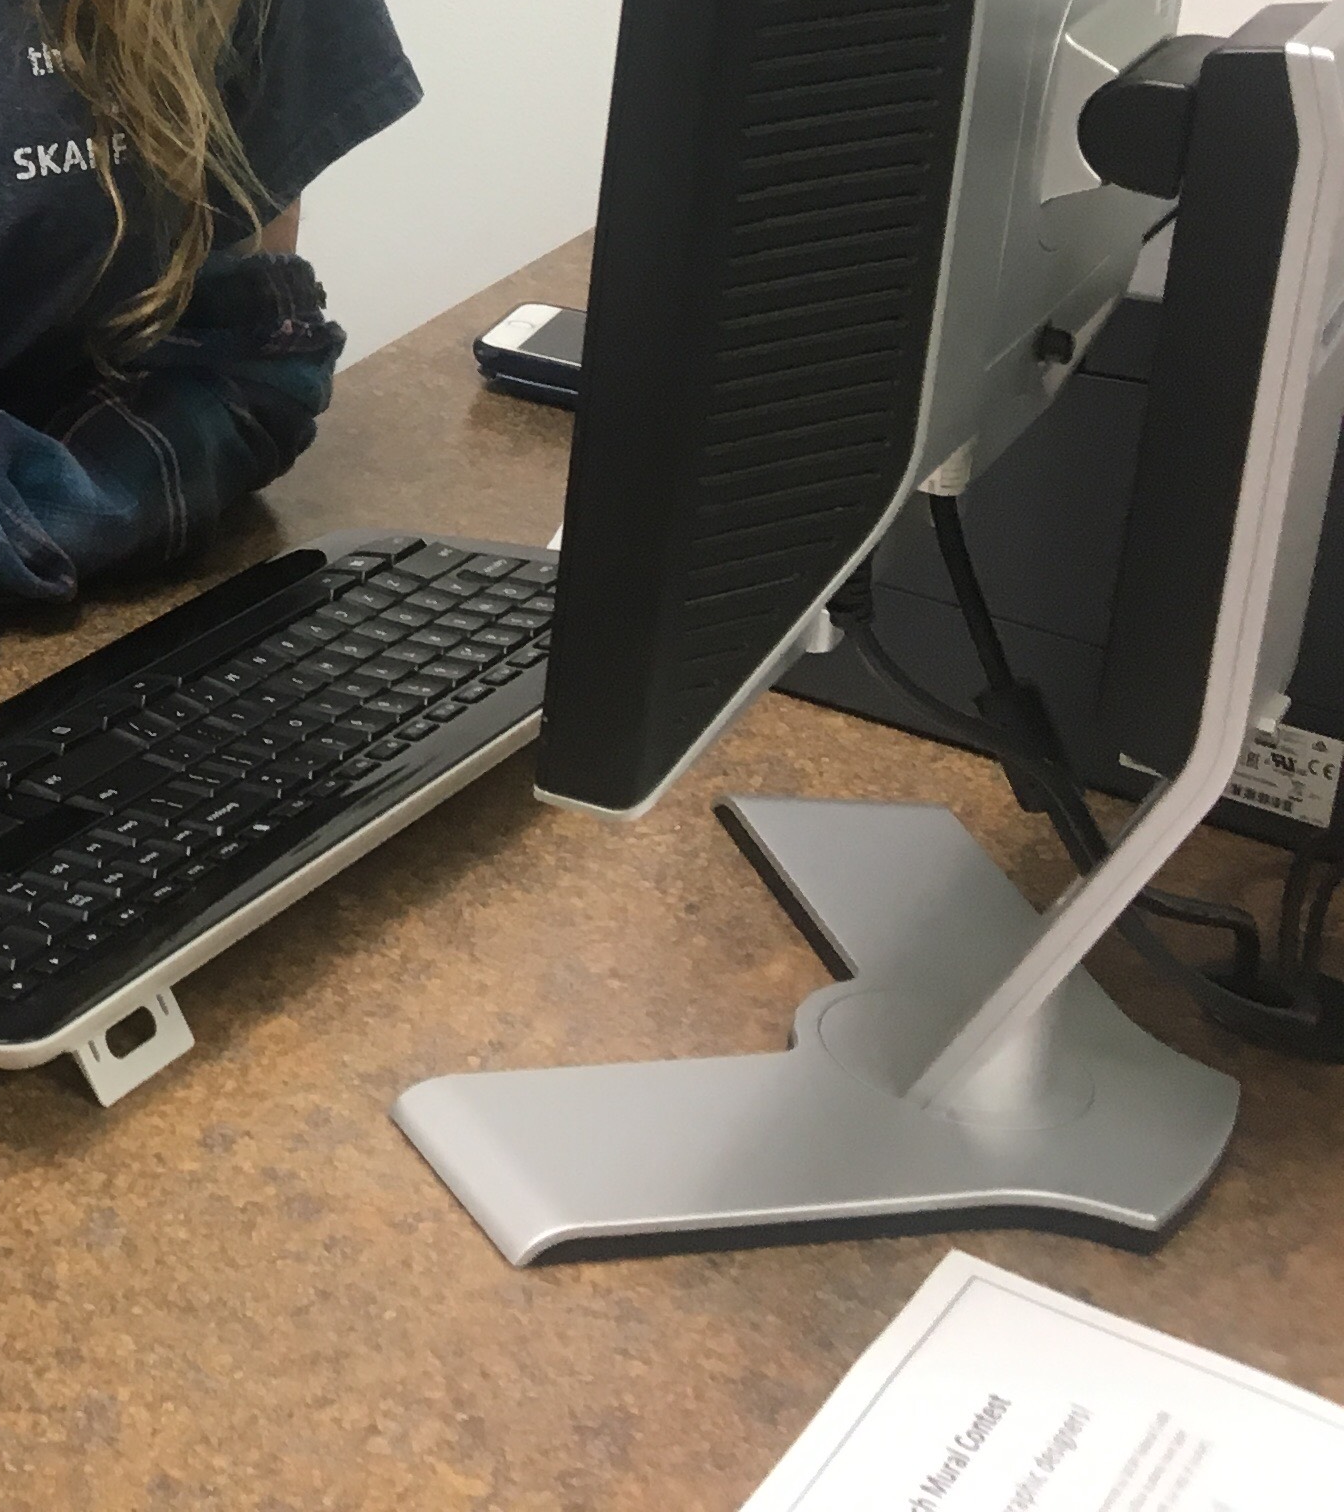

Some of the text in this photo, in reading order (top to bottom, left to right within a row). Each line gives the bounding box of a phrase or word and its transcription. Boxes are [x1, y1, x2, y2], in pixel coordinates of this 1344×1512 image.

[13, 133, 128, 180] SKAF
[920, 1445, 971, 1499] Mural
[954, 1393, 1012, 1453] Contest
